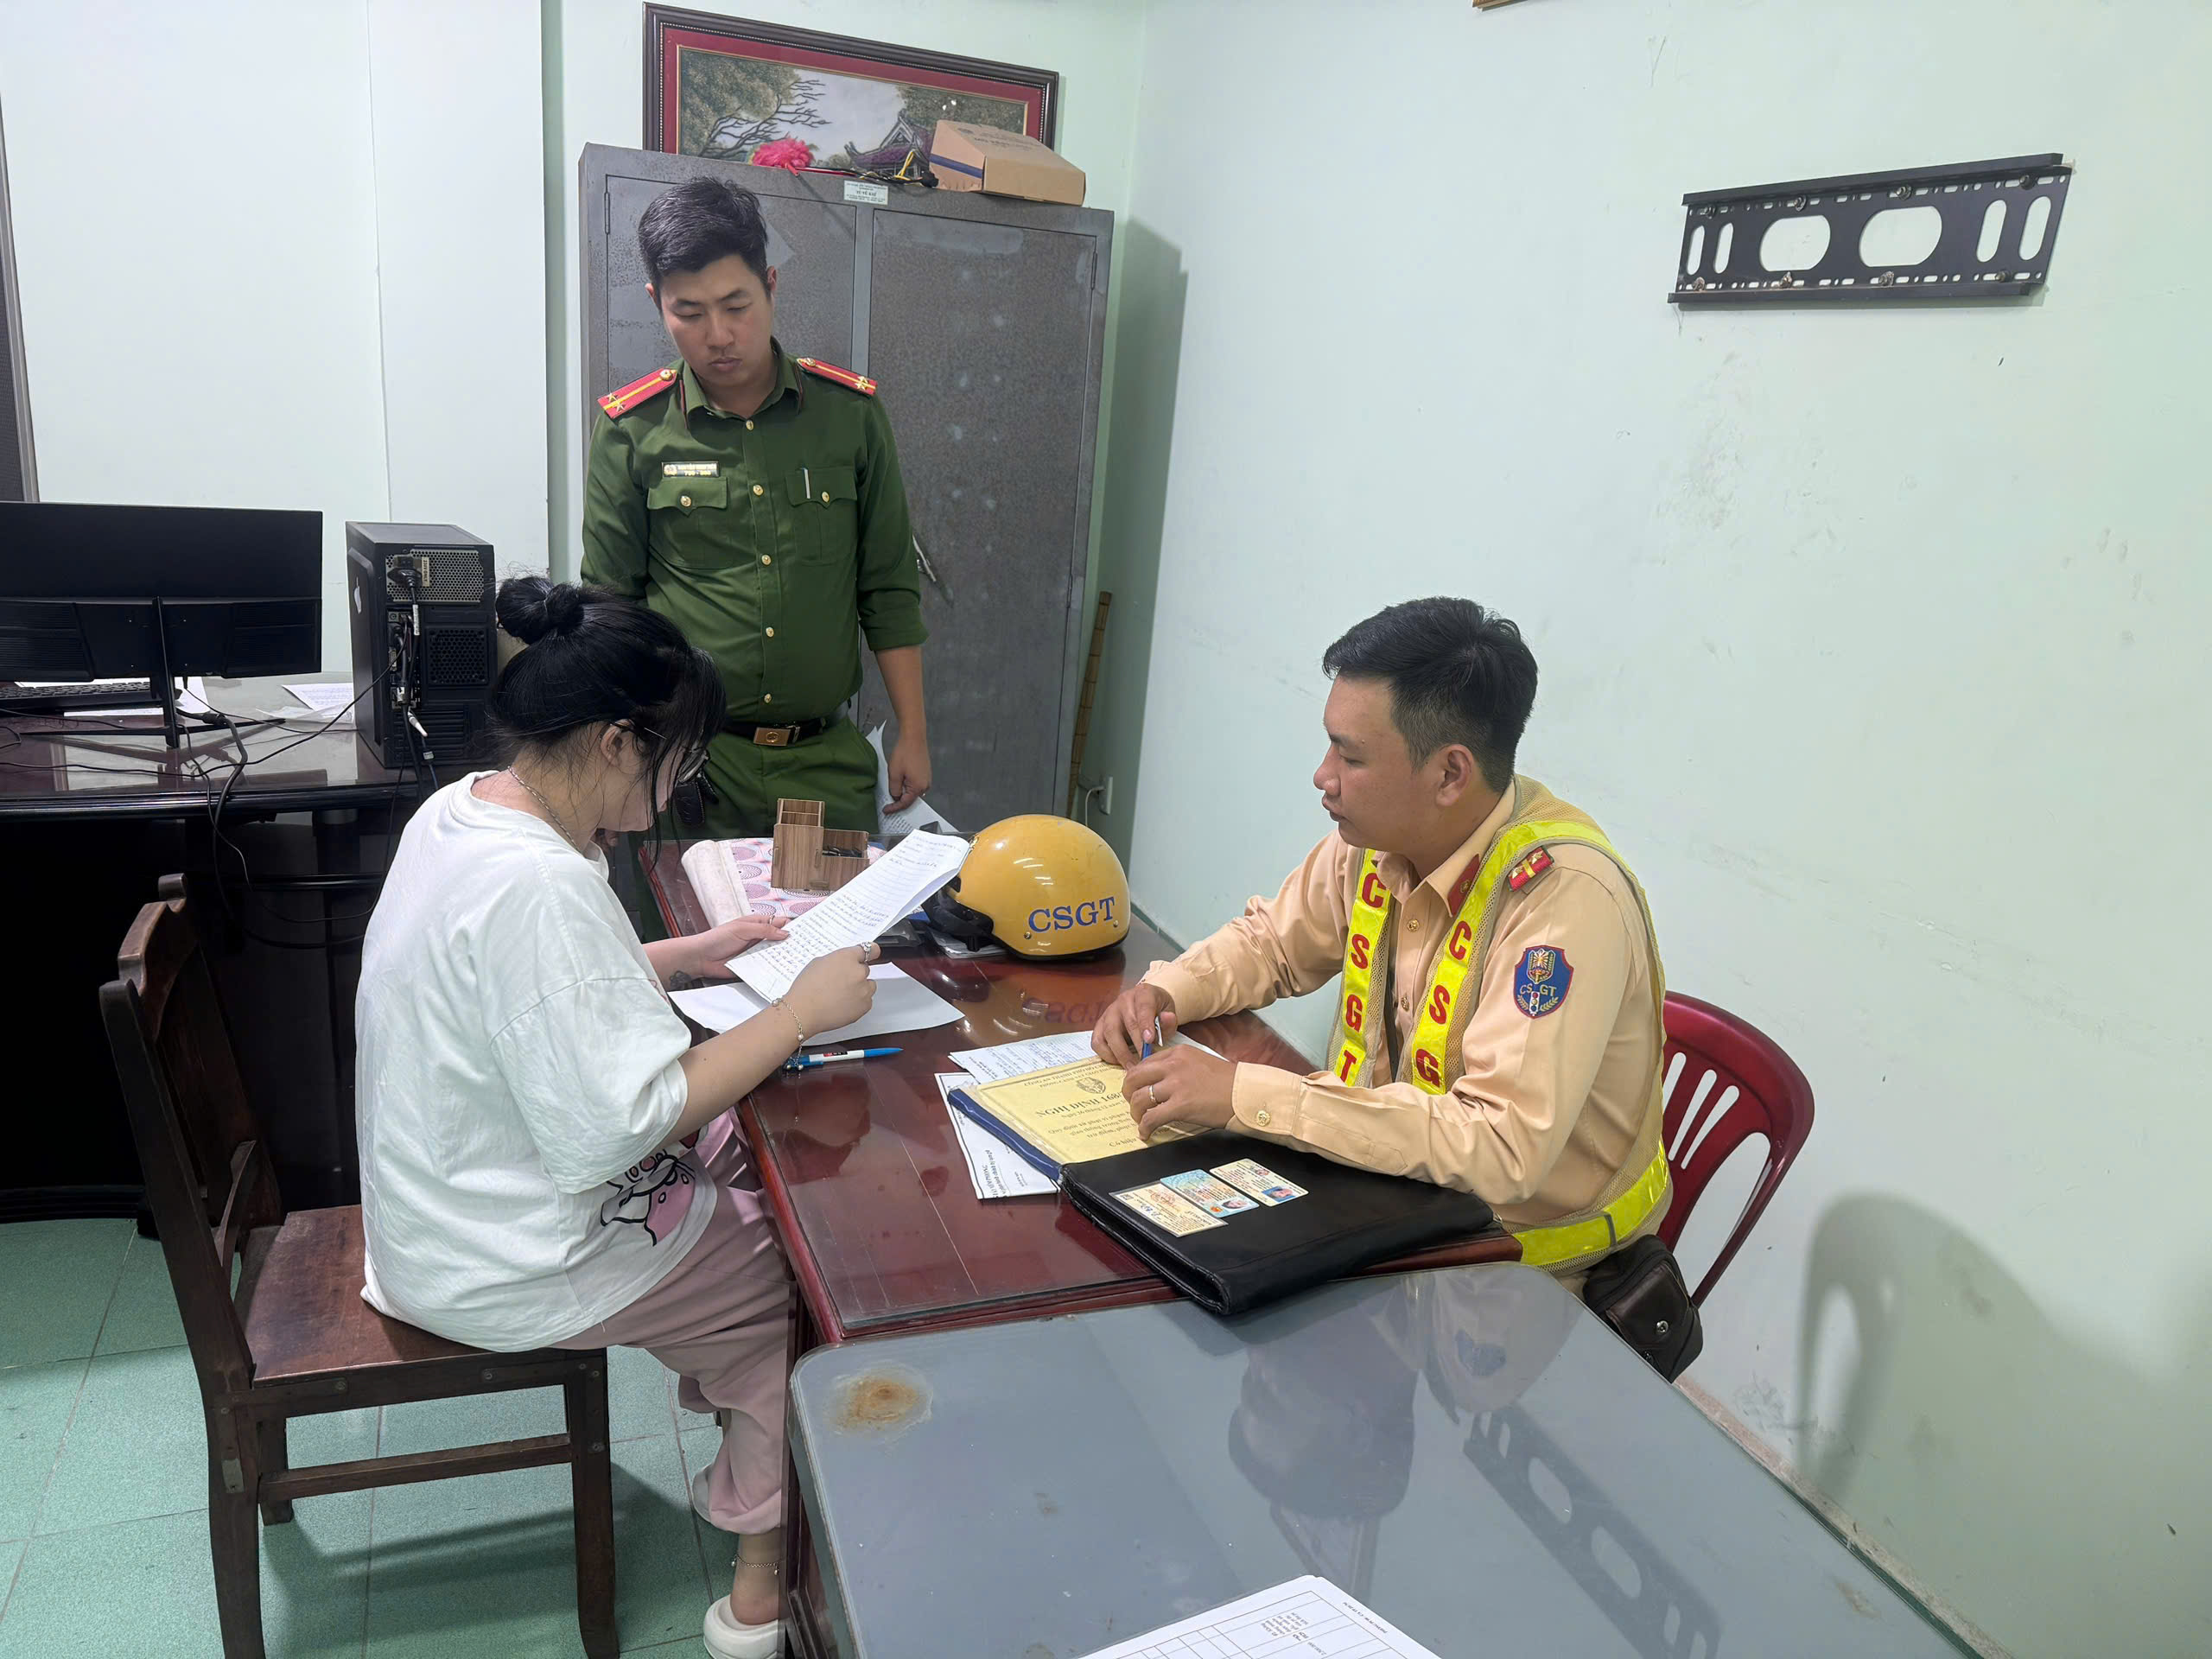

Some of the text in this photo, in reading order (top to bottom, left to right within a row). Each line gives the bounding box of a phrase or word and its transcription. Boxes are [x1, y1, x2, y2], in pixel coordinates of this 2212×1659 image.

[1028, 896, 1116, 933] CSGT
[1340, 873, 1387, 1084] CSGT
[1036, 1106, 1071, 1117] NGHỊ
[1070, 1098, 1100, 1109] ĐỊNH
